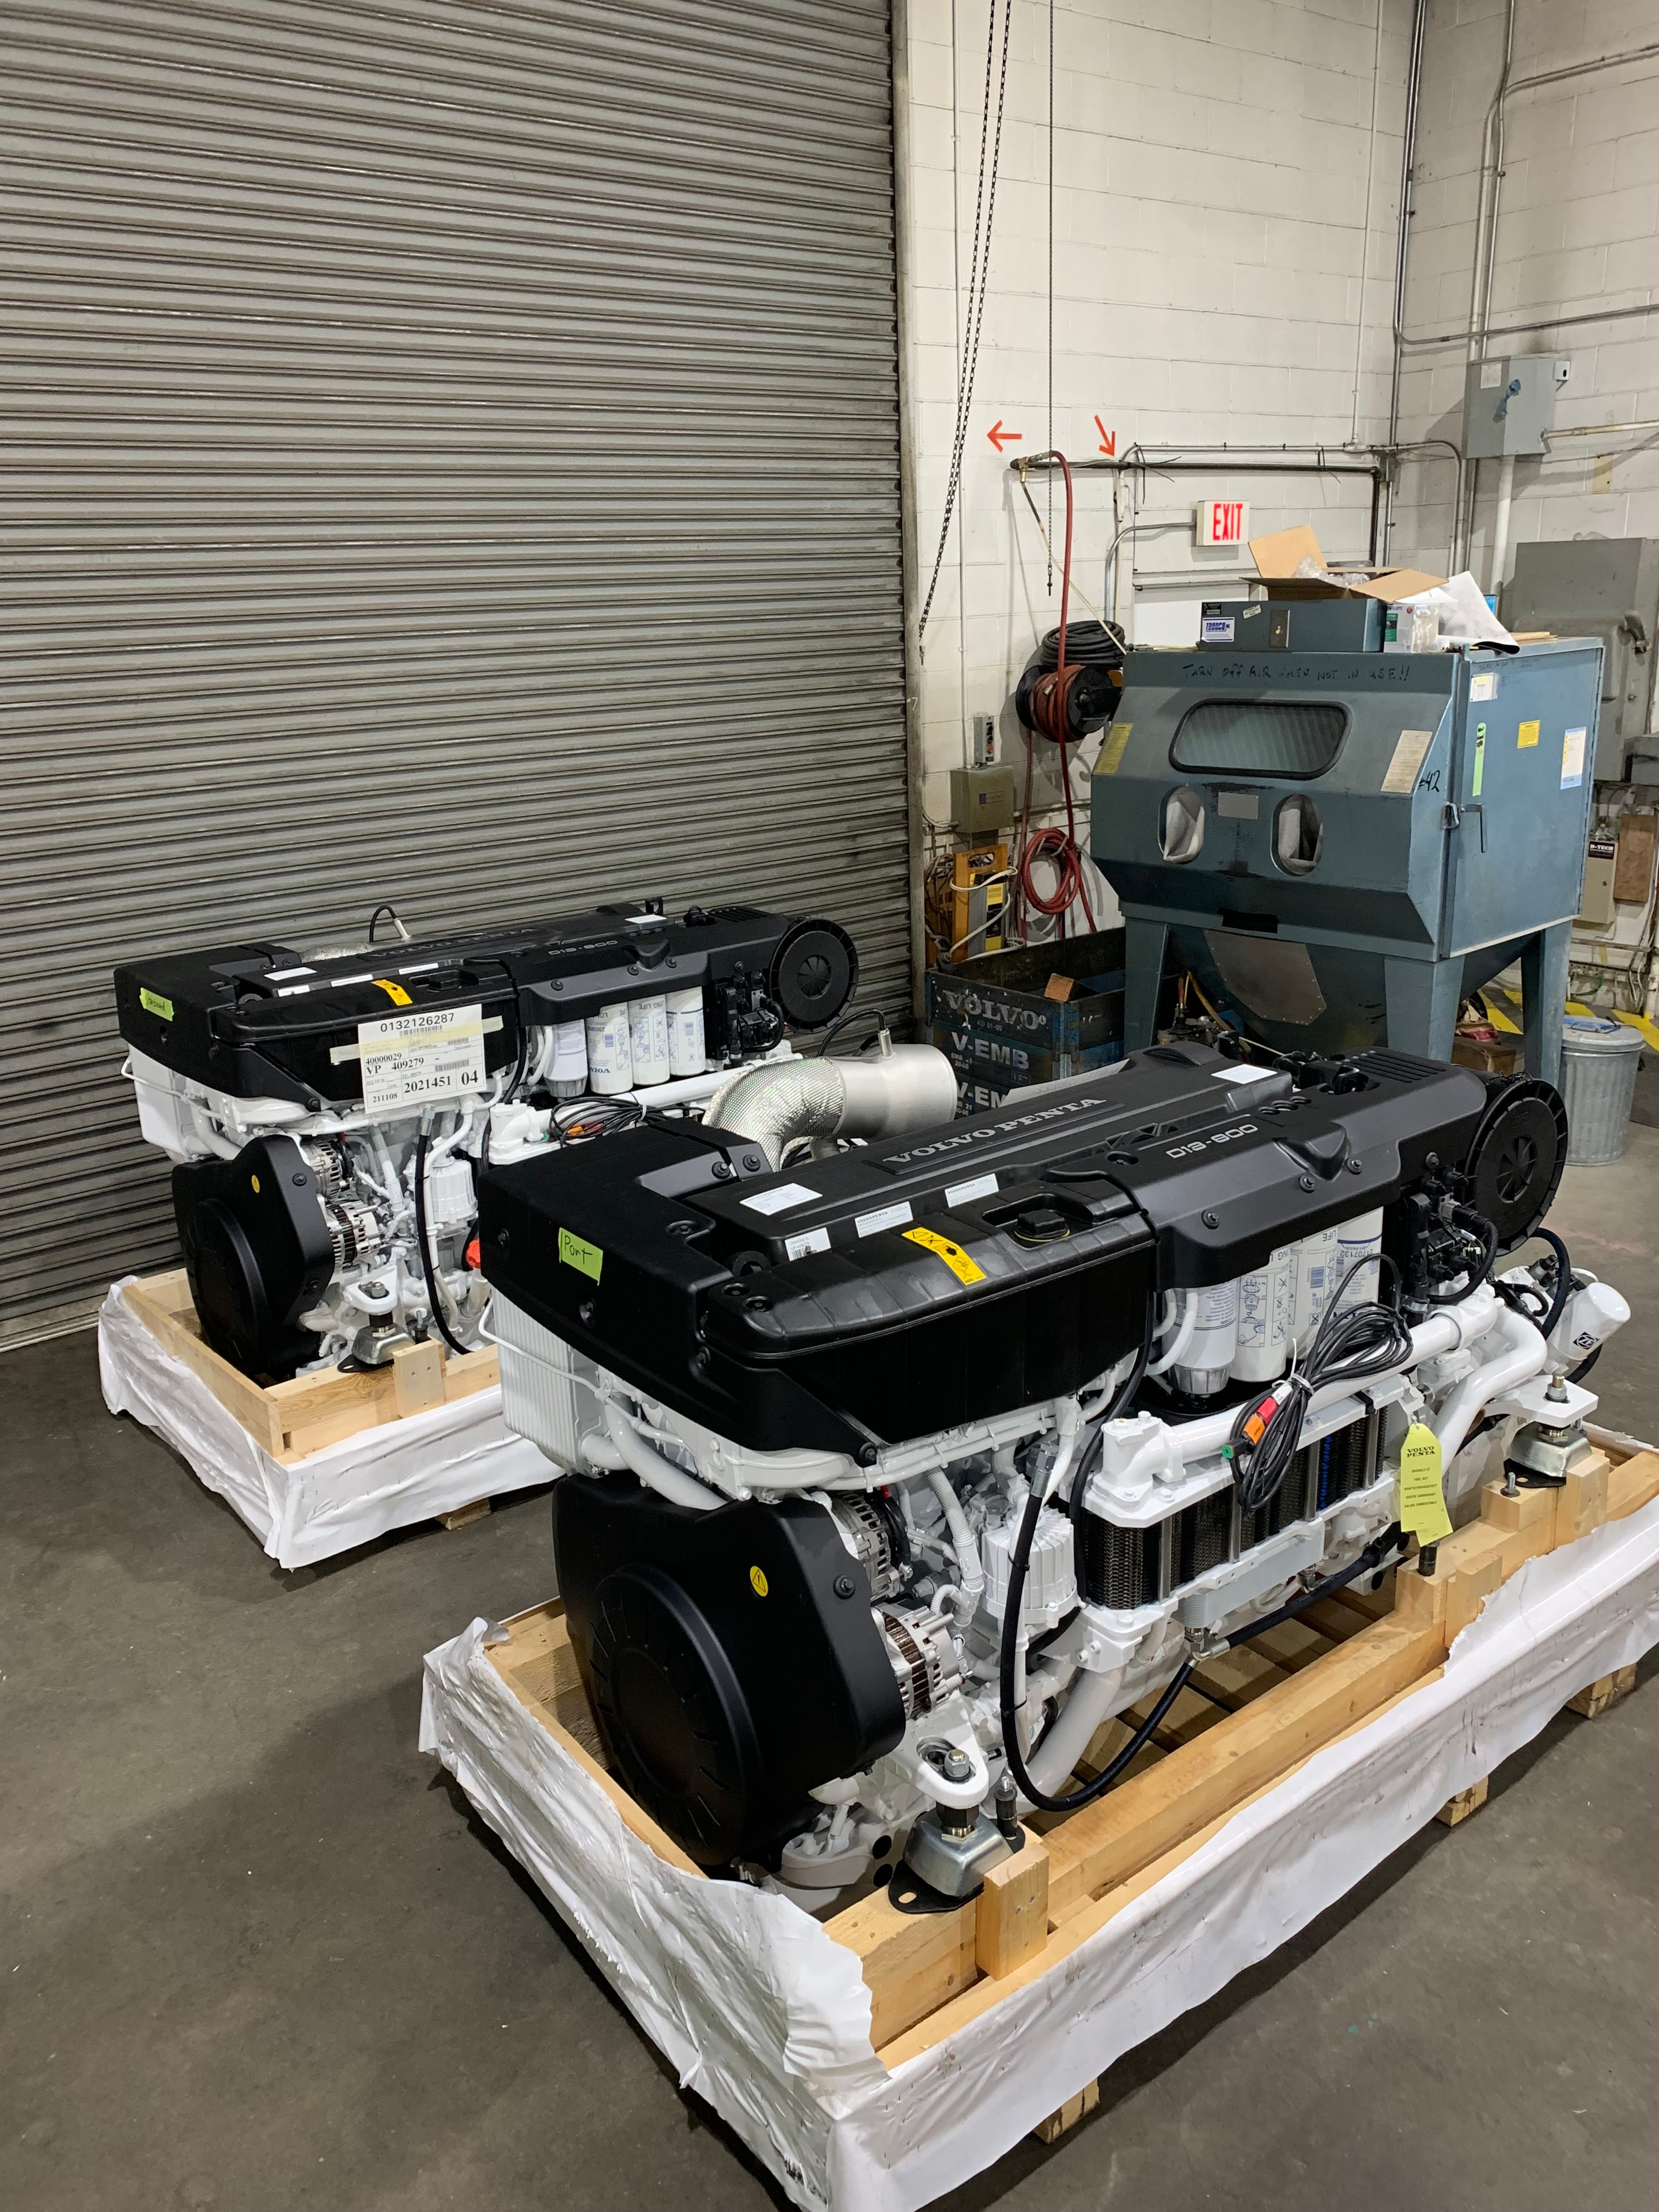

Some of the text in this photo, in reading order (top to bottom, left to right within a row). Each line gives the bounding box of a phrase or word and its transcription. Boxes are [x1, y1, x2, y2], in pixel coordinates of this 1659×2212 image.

[1213, 503, 1243, 540] EXIT
[1249, 665, 1271, 679] AIR
[1317, 669, 1338, 681] NOT
[1418, 770, 1441, 793] #42
[942, 990, 1039, 1030] VOLVO
[380, 1013, 454, 1032] 0132126287
[365, 1052, 402, 1066] 40000029
[951, 1031, 1029, 1070] V-EMB
[366, 1065, 381, 1075] VP
[391, 1057, 424, 1071] 409279
[404, 1075, 452, 1093] 2021451
[461, 1070, 479, 1086] 04
[373, 1092, 397, 1103] 211108
[882, 1098, 1107, 1163] VOLVO PENTA
[565, 1234, 593, 1265] Port
[1339, 1248, 1374, 1259] 21707132
